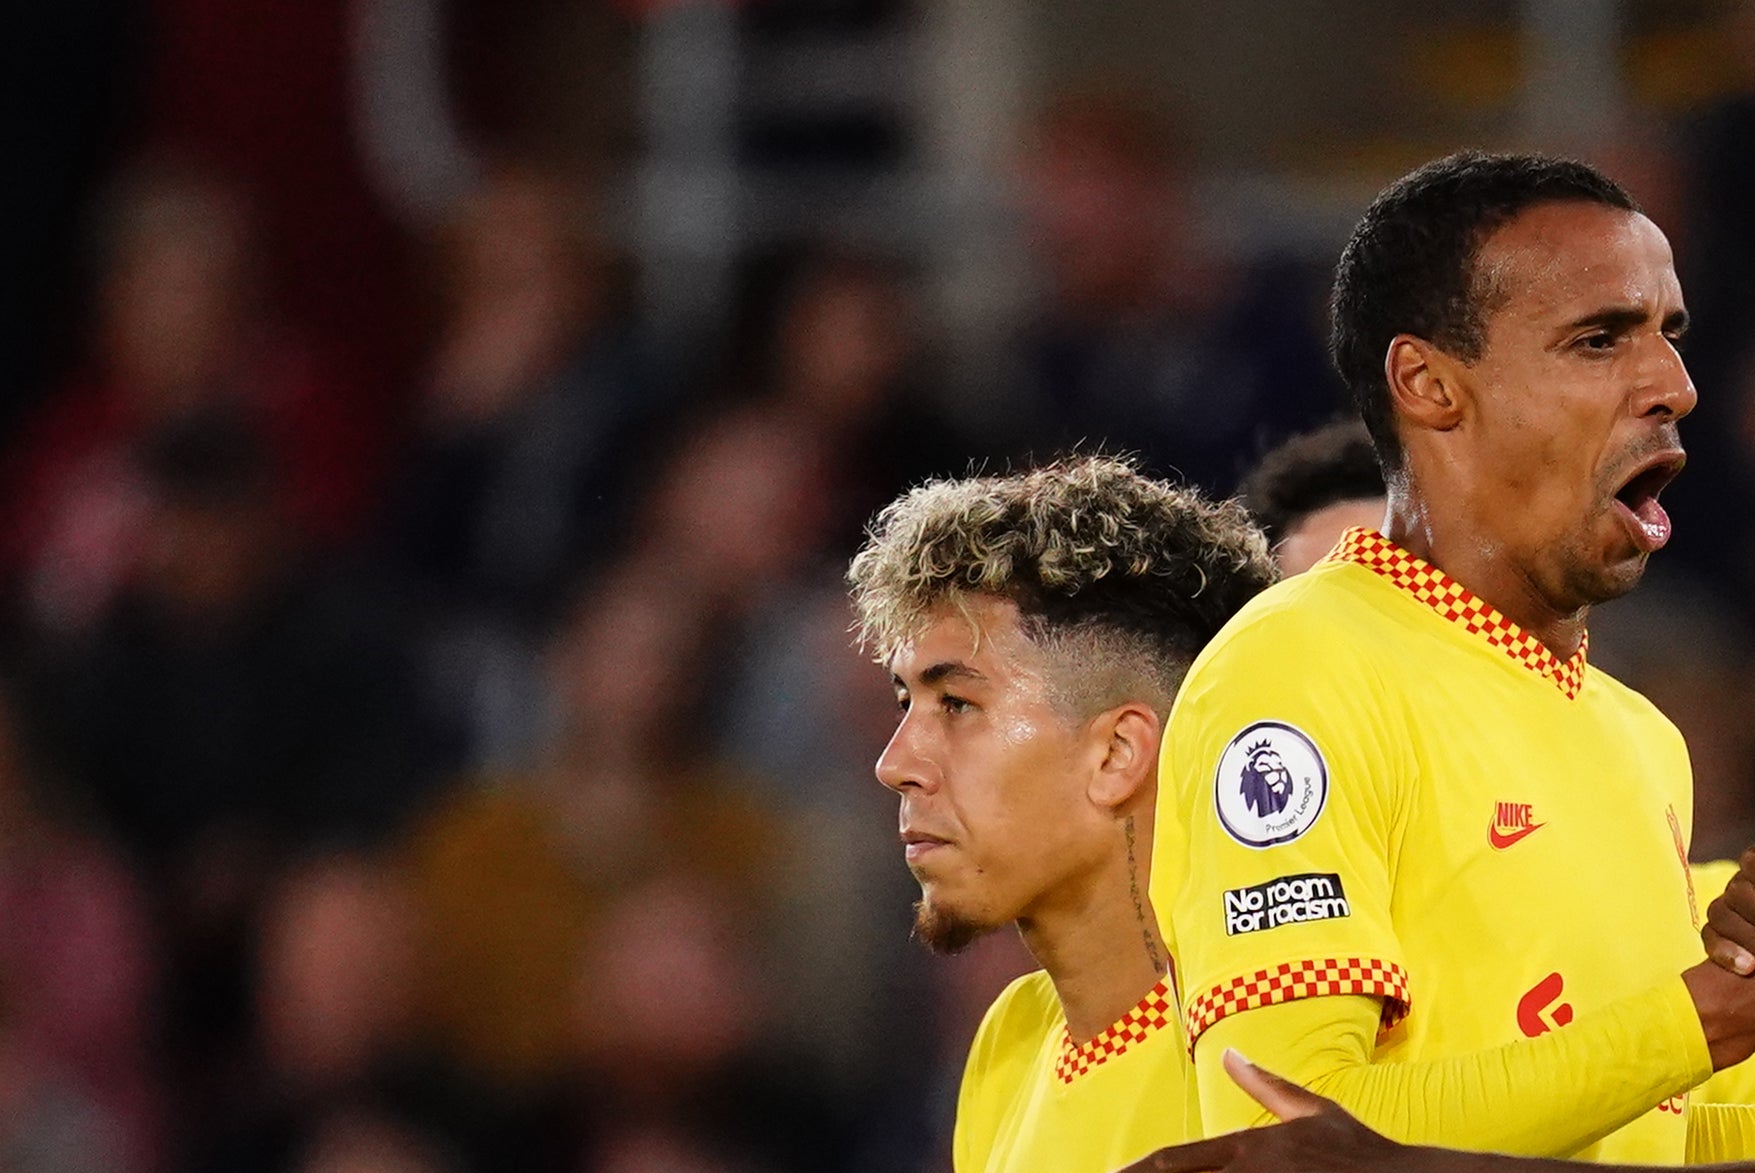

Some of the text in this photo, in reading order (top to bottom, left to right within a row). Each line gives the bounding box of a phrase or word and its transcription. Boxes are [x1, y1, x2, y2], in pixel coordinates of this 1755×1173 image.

[1265, 776, 1314, 834] Premier League
[1496, 802, 1534, 828] NIKE
[1224, 878, 1335, 913] No room
[1226, 898, 1350, 935] for racism
